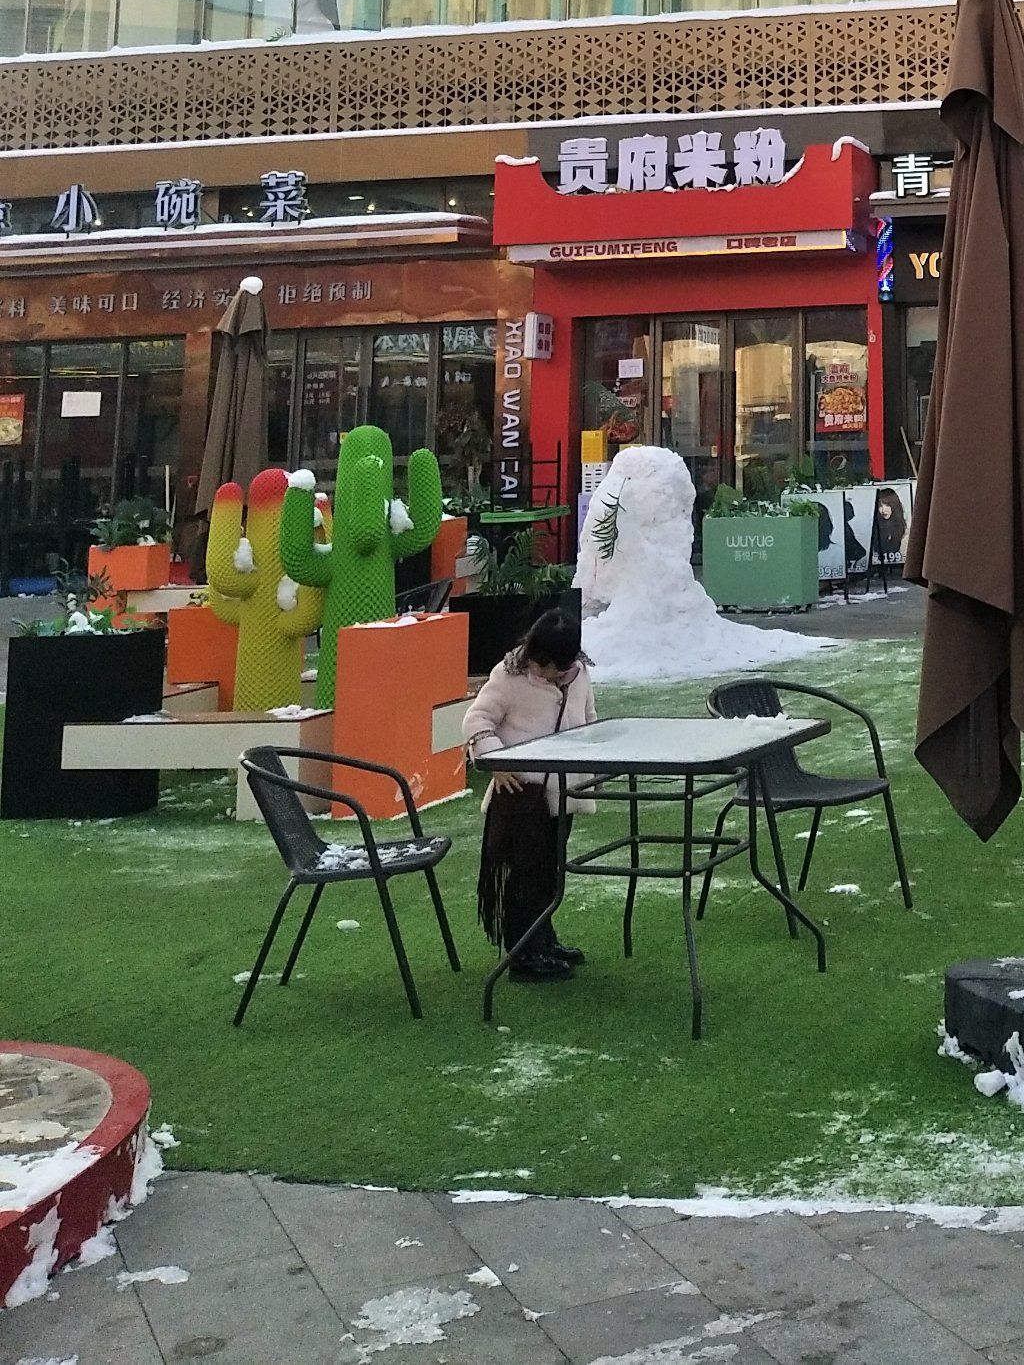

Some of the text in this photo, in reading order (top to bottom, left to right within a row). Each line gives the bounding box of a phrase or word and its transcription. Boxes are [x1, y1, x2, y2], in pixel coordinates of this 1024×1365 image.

[557, 129, 786, 194] 贵府米粉
[0, 170, 307, 233] 小碗菜
[550, 241, 678, 258] GUIFUMIFENG
[50, 291, 140, 315] 美味可口
[162, 288, 234, 310] 经济实
[278, 280, 373, 306] 拒绝预制
[503, 321, 523, 379] XIAO
[501, 389, 520, 448] WAN
